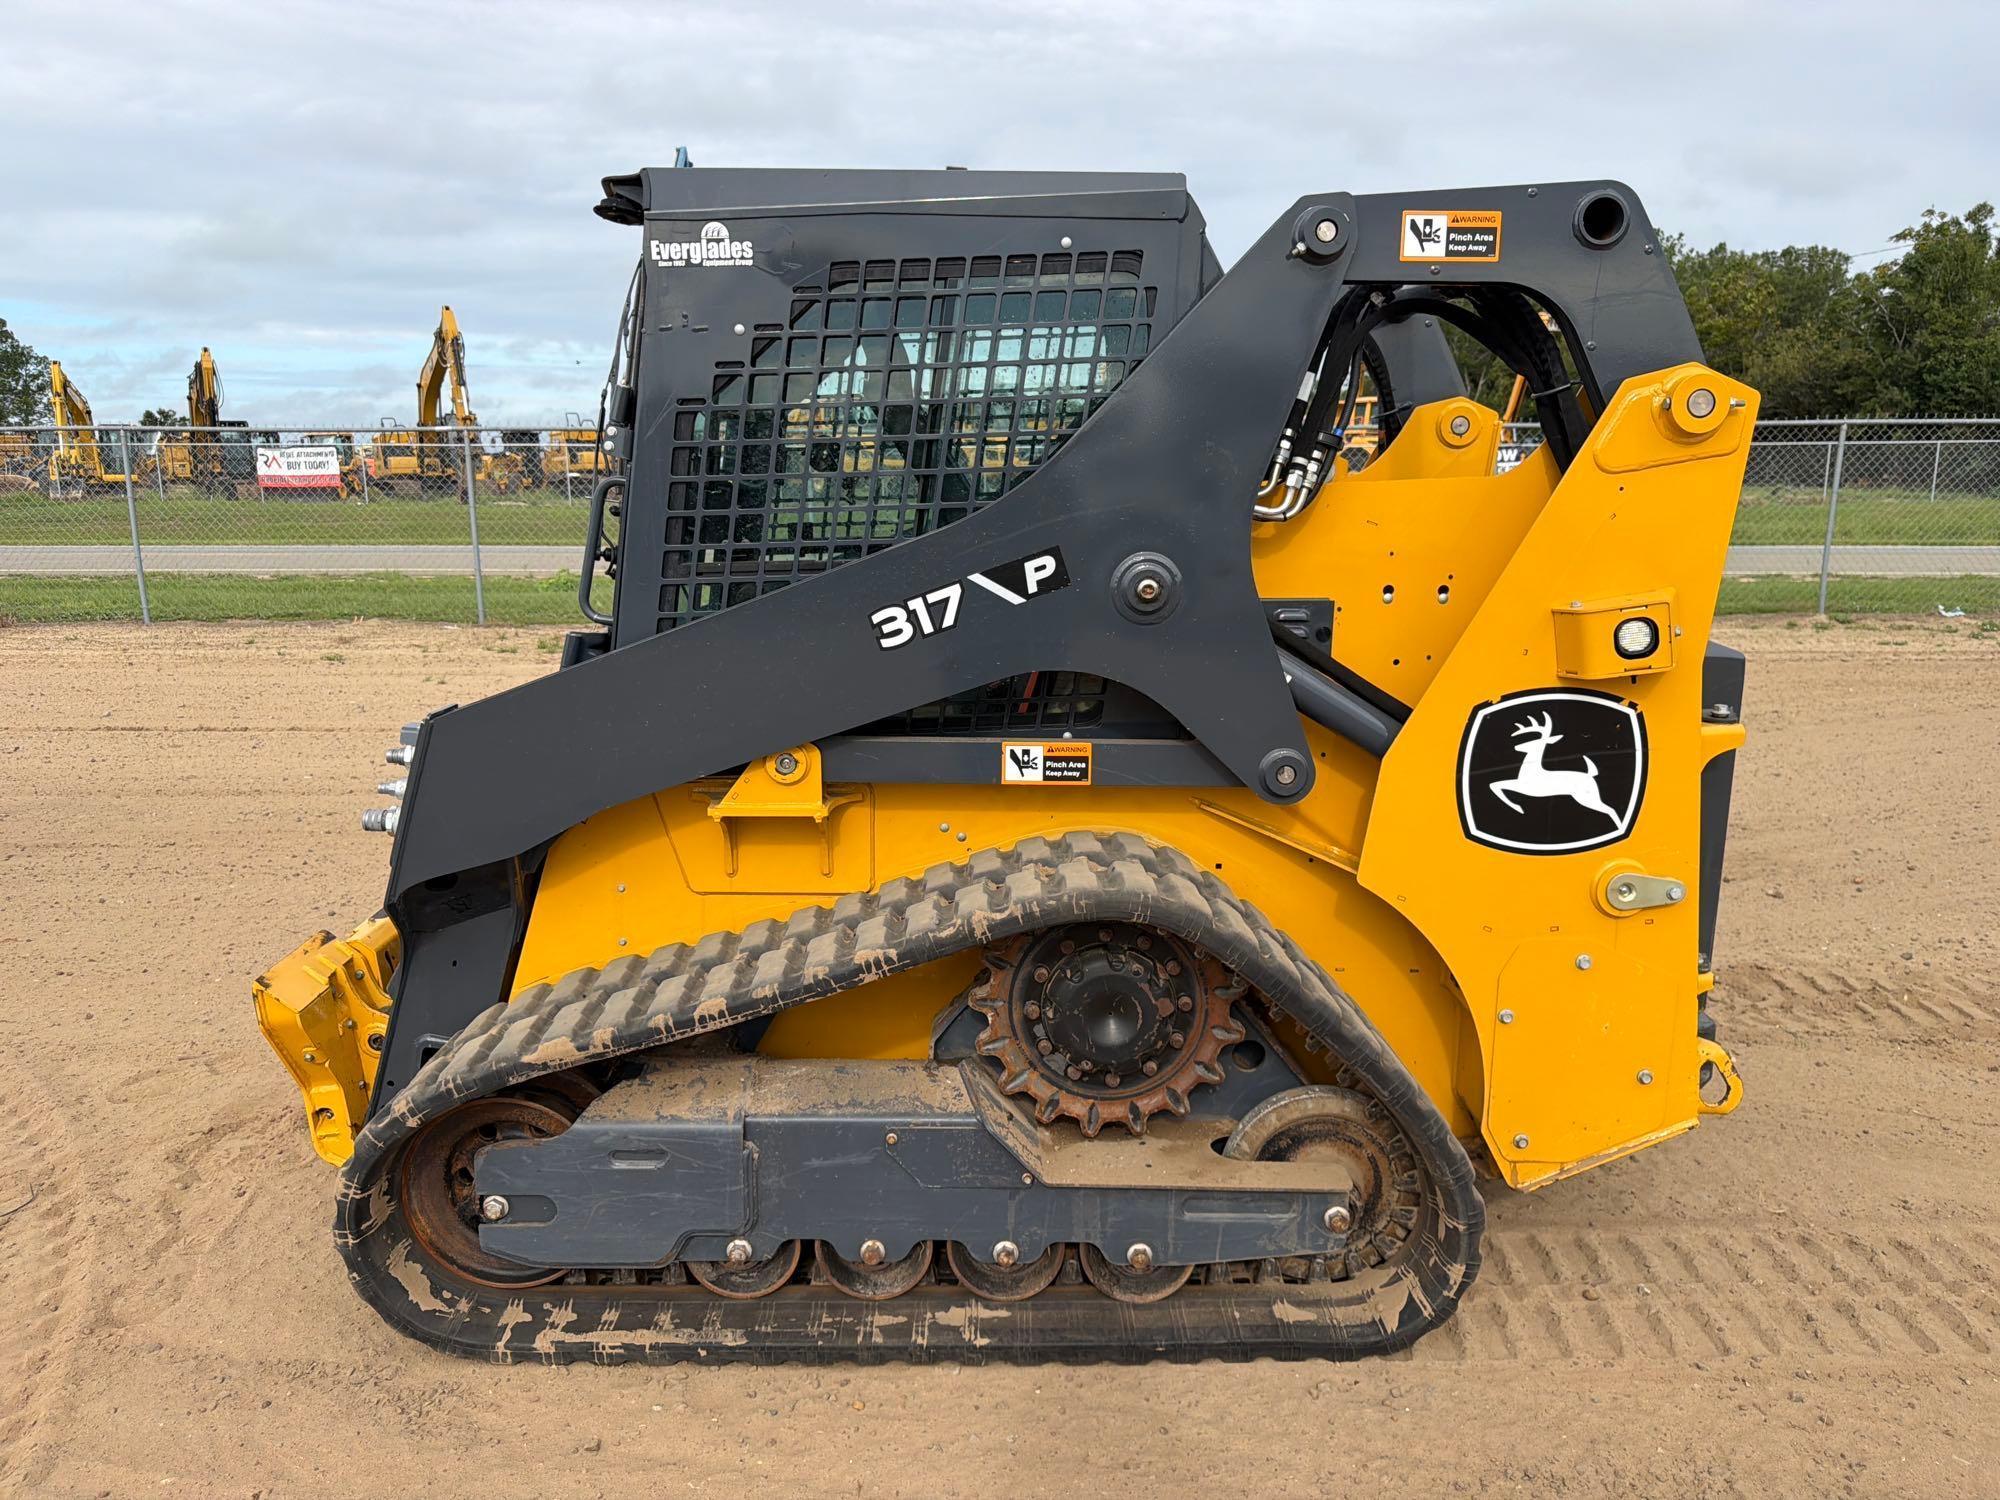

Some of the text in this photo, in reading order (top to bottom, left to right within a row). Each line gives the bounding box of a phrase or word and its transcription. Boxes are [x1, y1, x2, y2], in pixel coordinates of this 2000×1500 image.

[1449, 233, 1494, 241] Pinch Area
[650, 238, 754, 264] Everglades
[1448, 244, 1487, 252] Keep Away
[702, 259, 734, 267] Equipment
[286, 460, 330, 470] BUY TODAY!
[871, 583, 962, 648] 317
